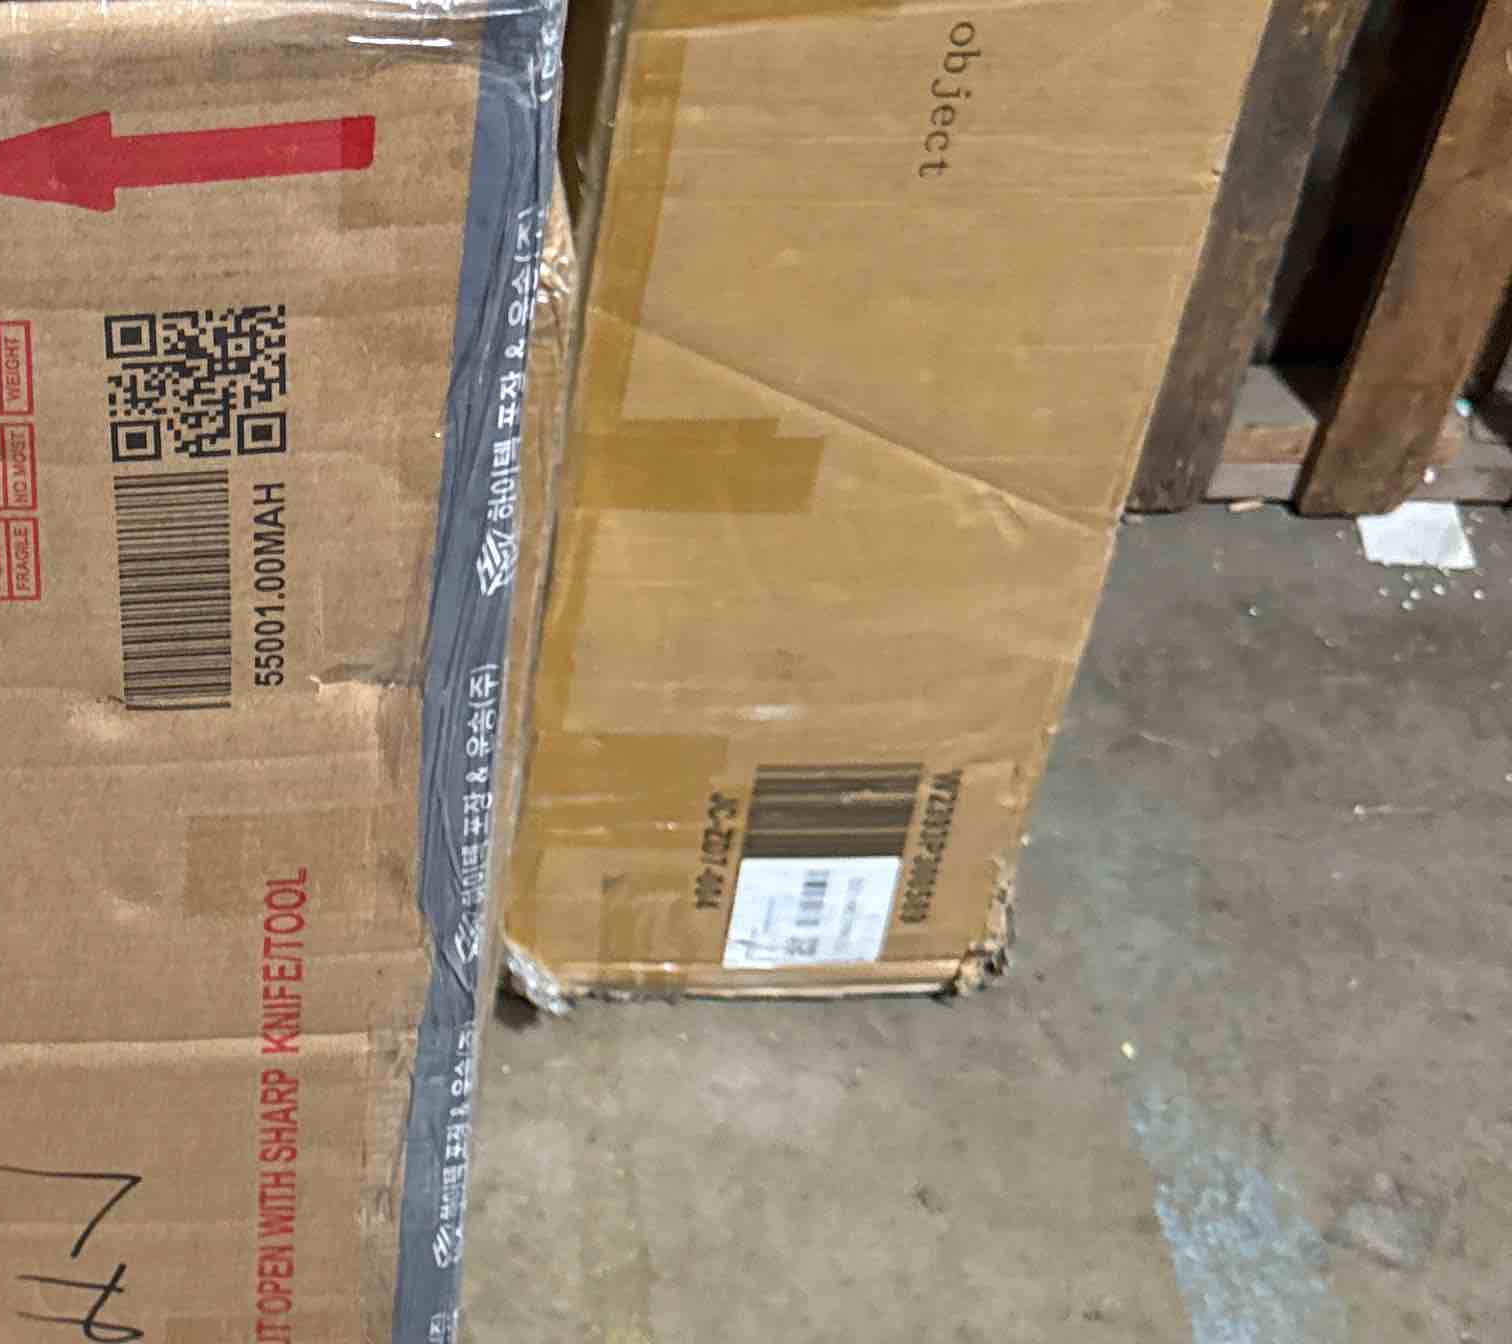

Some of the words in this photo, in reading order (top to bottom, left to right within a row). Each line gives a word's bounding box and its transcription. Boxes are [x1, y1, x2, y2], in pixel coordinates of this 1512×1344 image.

[918, 21, 979, 177] object
[4, 336, 21, 401] WEIGHT
[14, 527, 31, 591] FRAGILE
[255, 483, 286, 686] 55001.00MAH
[262, 867, 309, 1053] KNIFE/TOOL
[260, 1068, 299, 1168] SHARP
[258, 1173, 296, 1234] WITH
[256, 1238, 295, 1309] OPEN
